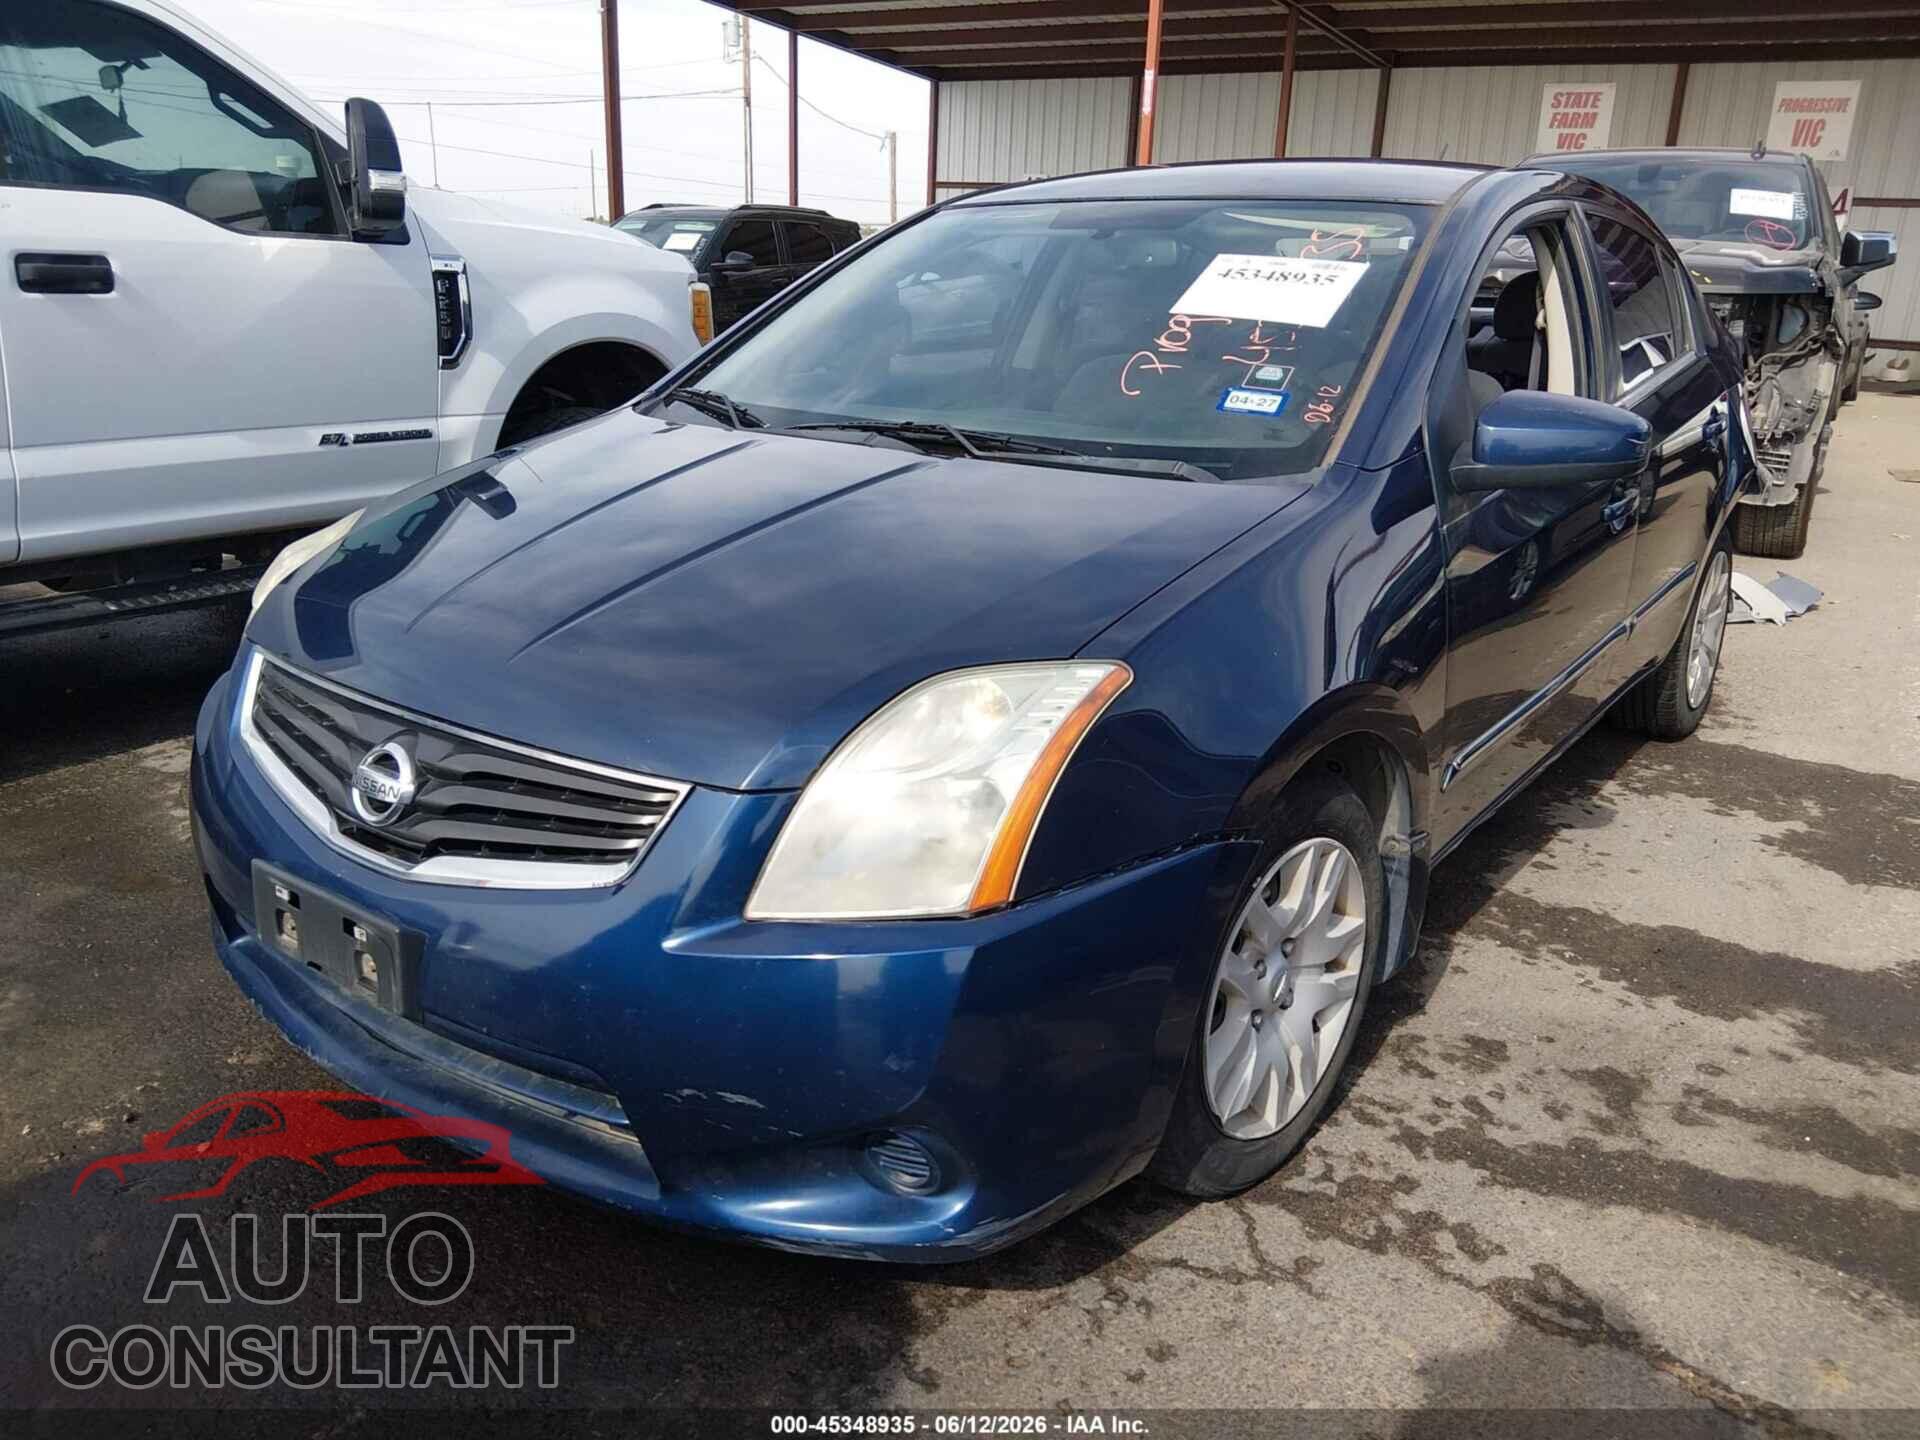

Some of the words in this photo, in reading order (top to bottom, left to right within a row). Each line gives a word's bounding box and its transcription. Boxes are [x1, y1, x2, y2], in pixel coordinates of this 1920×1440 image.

[1551, 91, 1604, 109] STATE
[1777, 97, 1851, 113] PROGRESSIVE
[1549, 111, 1599, 129] FARM
[1556, 132, 1588, 150] VIC
[1791, 118, 1826, 148] VIC
[1217, 267, 1340, 288] 45348935
[352, 775, 401, 800] NISSAN
